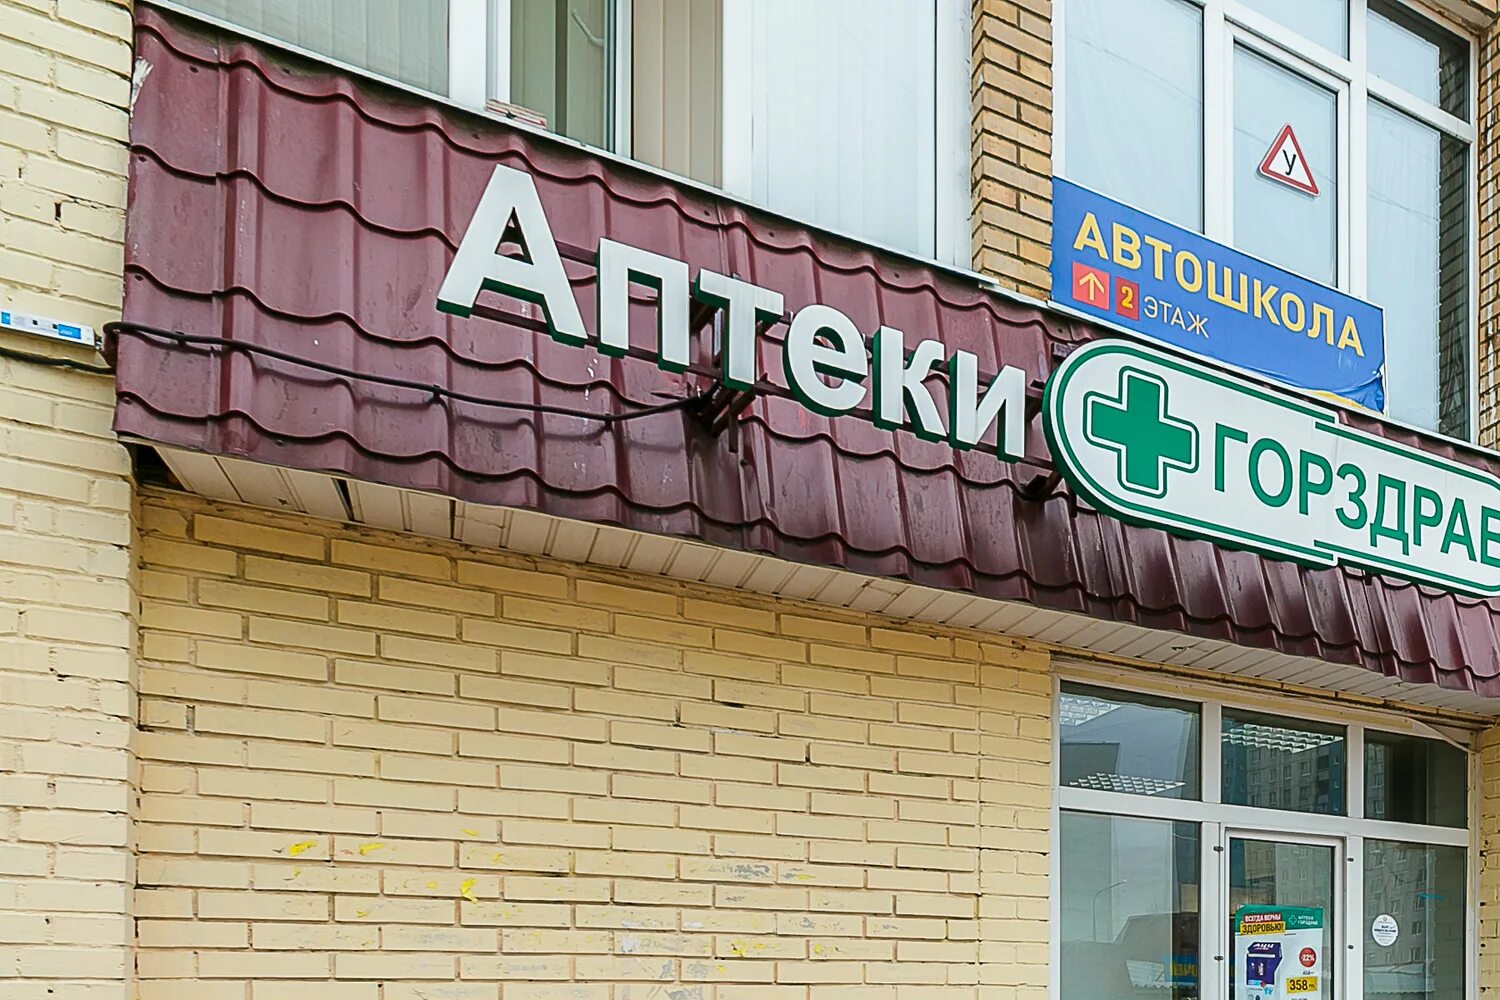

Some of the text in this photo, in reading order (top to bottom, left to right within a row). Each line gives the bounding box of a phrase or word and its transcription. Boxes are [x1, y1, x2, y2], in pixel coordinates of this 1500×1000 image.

[1072, 212, 1365, 357] АВТОШКОЛА
[436, 163, 1027, 463] Аптеки
[1118, 285, 1210, 339] 2 ЭТАЖ
[1242, 923, 1284, 934] ЗДОРОВЬЮ!
[1245, 913, 1281, 922] ВСЕГДА ВЕРНЫ
[1289, 979, 1308, 991] 358
